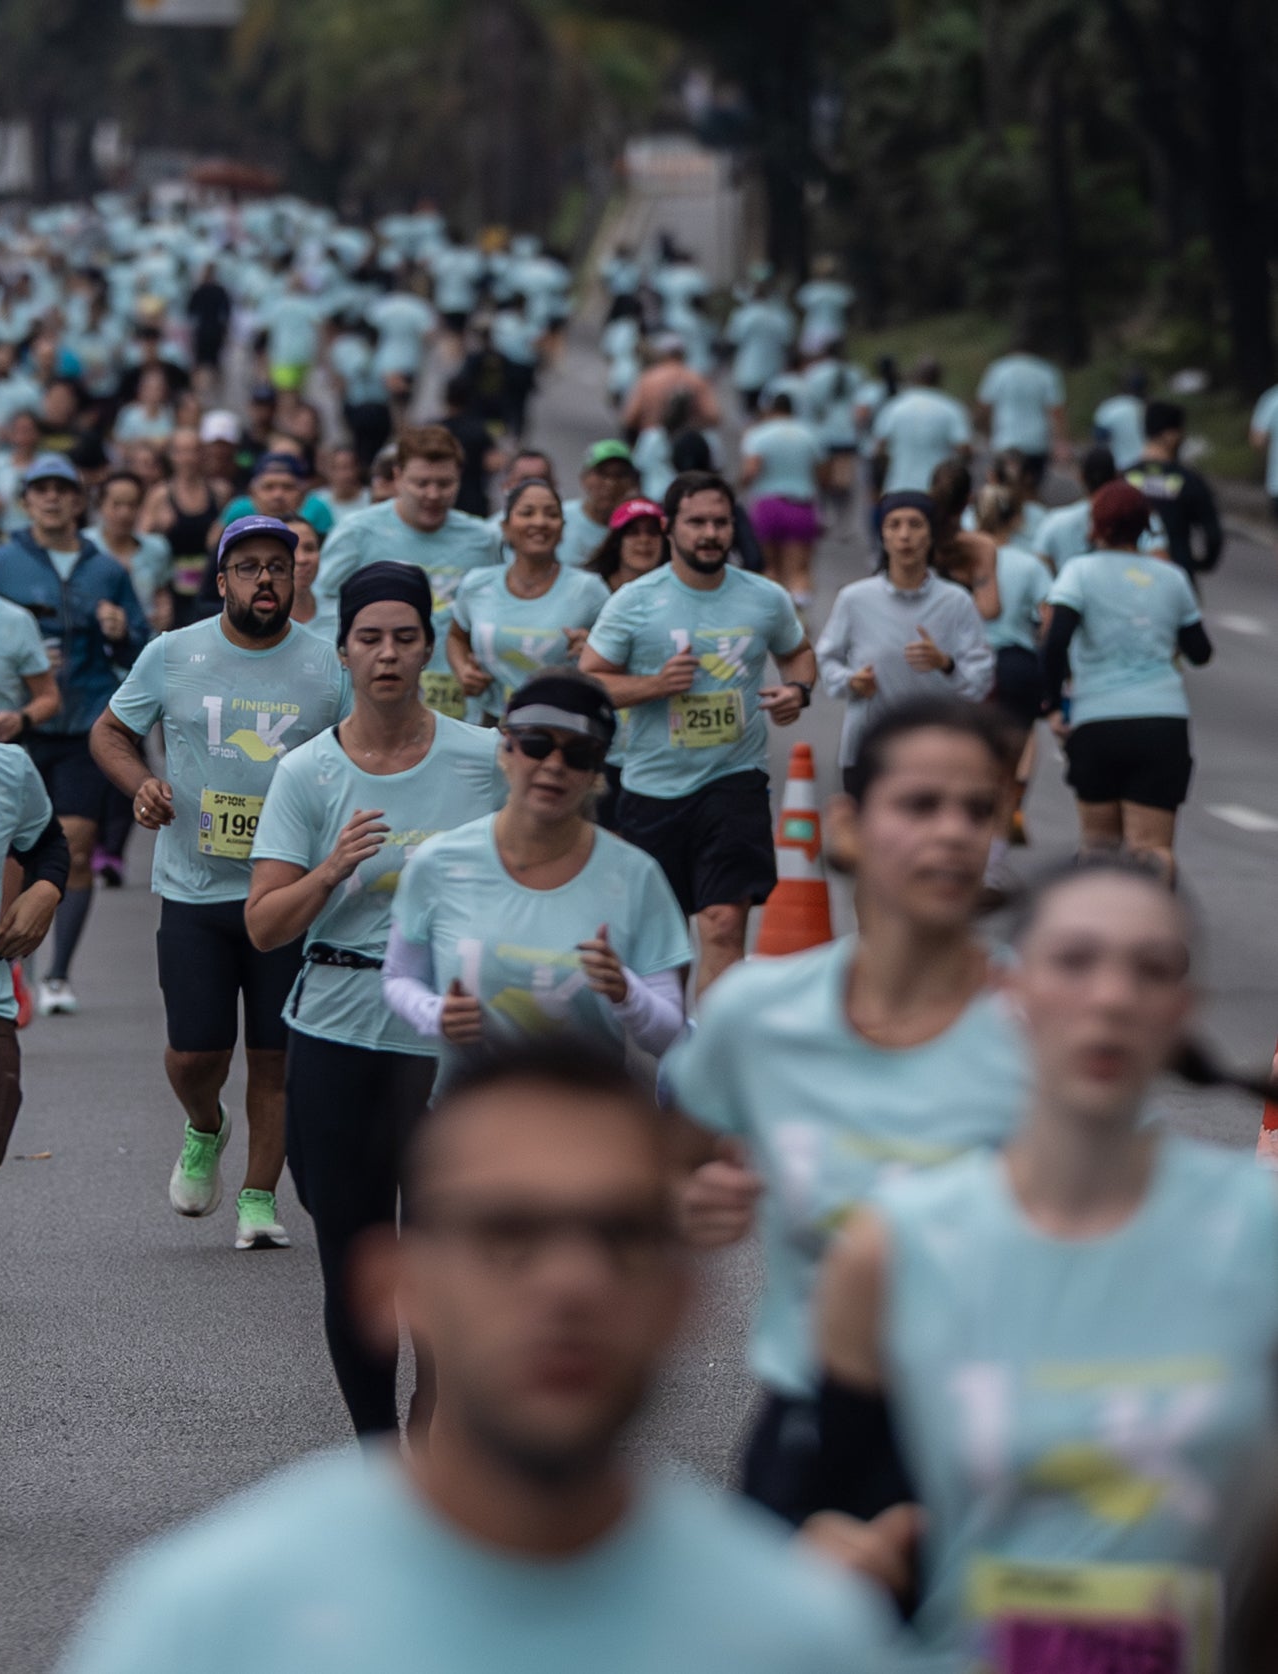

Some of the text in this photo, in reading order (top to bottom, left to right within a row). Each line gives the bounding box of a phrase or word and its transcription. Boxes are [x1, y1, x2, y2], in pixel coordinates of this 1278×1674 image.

[232, 698, 301, 715] FINISHER
[686, 706, 737, 729] 2516
[214, 793, 247, 808] SP10K
[218, 811, 261, 838] 199
